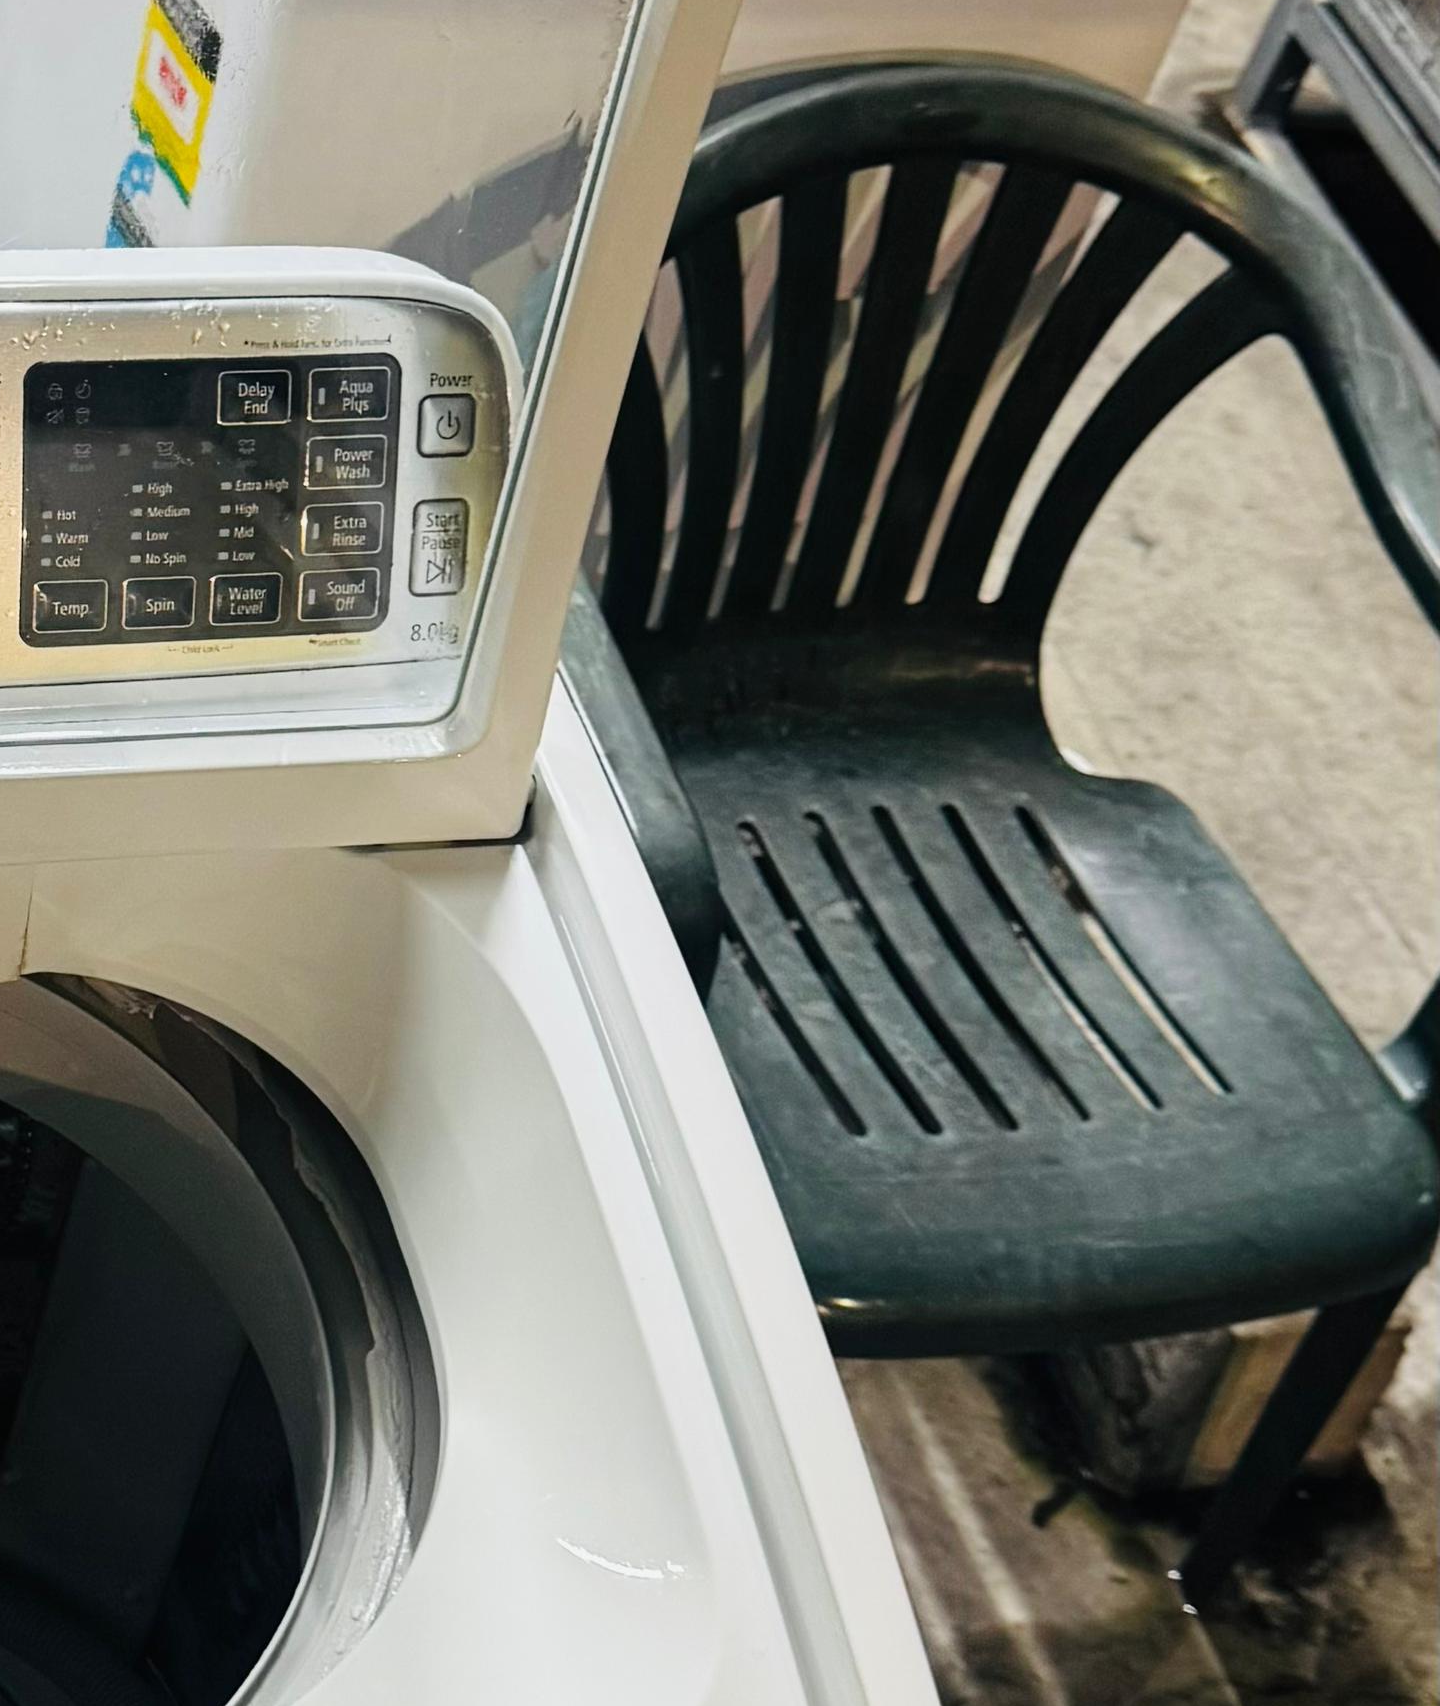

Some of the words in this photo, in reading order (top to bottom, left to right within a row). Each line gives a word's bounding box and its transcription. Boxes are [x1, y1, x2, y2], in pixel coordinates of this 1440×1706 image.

[429, 372, 474, 389] Power
[238, 381, 275, 401] Delay
[339, 380, 374, 400] Aqua
[243, 400, 269, 415] End
[334, 447, 374, 464] Power
[335, 463, 372, 480] Wash
[147, 482, 173, 497] High
[234, 480, 262, 493] Extra
[263, 477, 290, 492] High
[56, 509, 77, 522] Hot
[146, 504, 191, 518] Medium
[234, 502, 260, 518] High
[333, 513, 367, 530] Extra
[425, 511, 461, 529] Start
[55, 532, 89, 545] Warm
[146, 529, 170, 542] Low
[233, 526, 255, 540] Mid
[332, 530, 367, 547] Rinse
[420, 534, 461, 552] Pause
[55, 554, 81, 569] Cold
[145, 552, 161, 565] No
[162, 551, 188, 568] Spin
[232, 549, 257, 562] Low
[227, 585, 268, 603] Water
[326, 579, 366, 596] Sound
[146, 596, 176, 616] Spin
[229, 599, 265, 616] Level
[335, 595, 356, 612] Off
